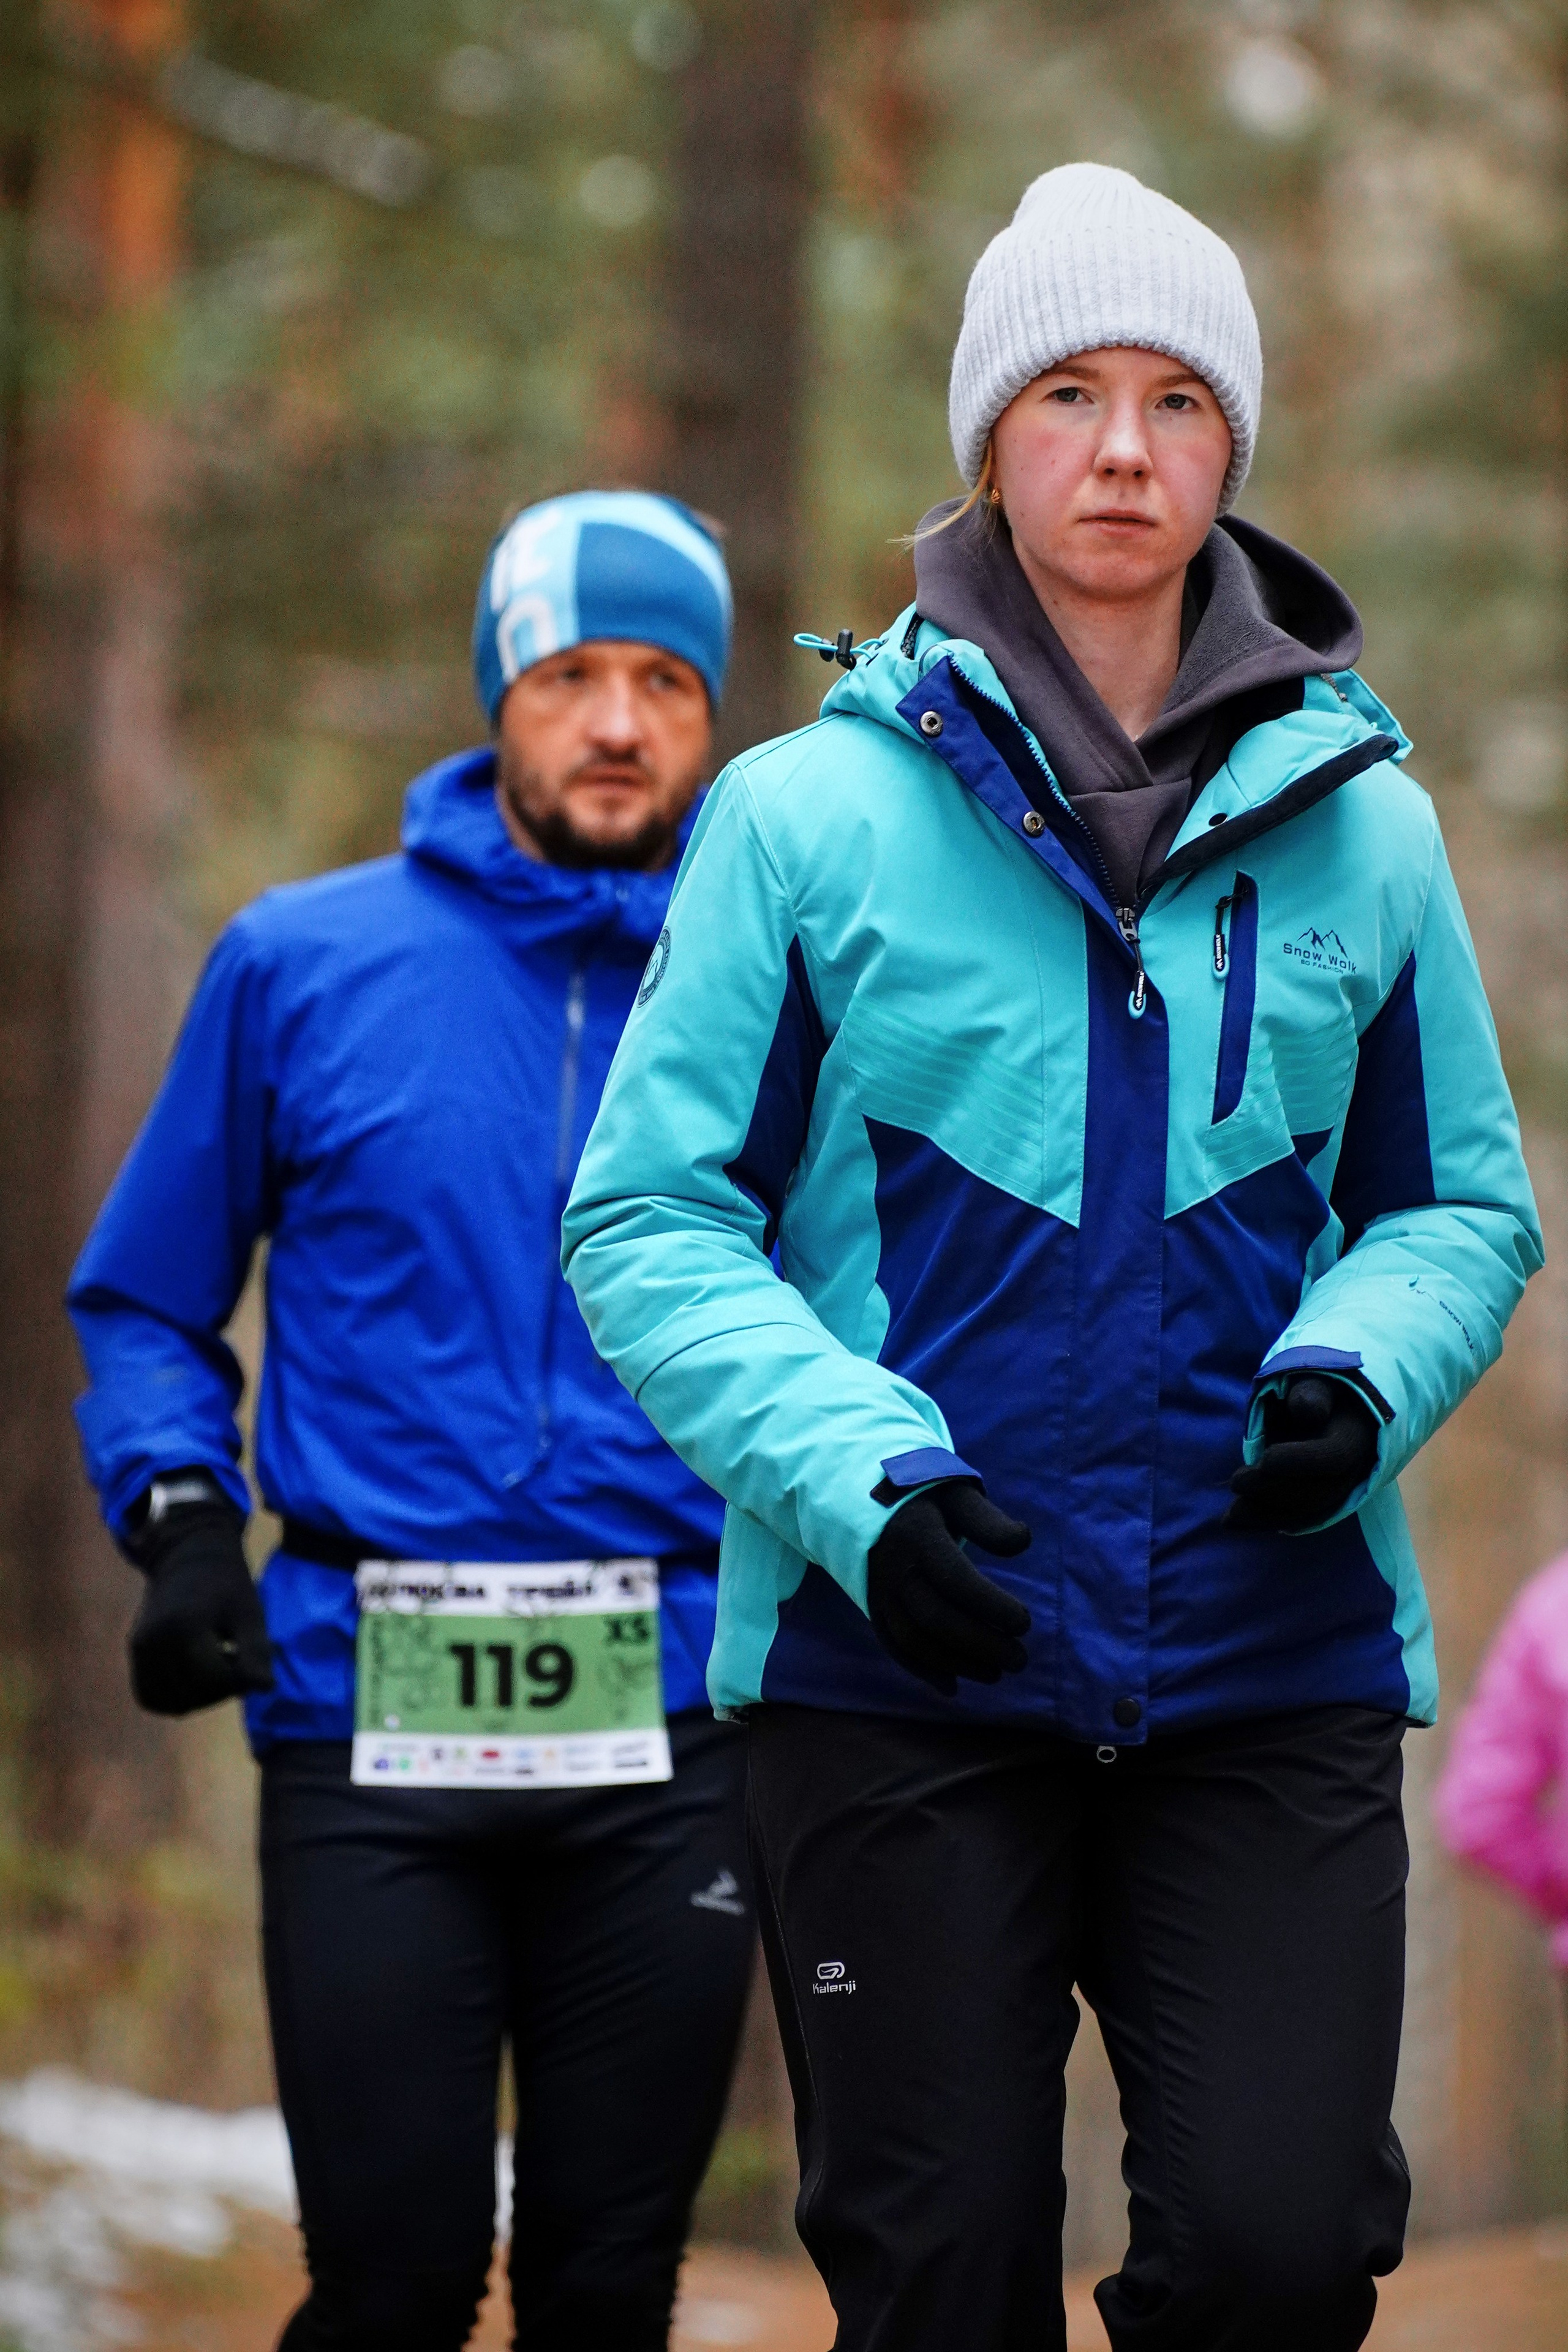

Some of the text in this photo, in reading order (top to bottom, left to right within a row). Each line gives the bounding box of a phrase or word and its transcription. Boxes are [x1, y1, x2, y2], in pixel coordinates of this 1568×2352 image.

[1283, 943, 1322, 961] Snow
[449, 1642, 575, 1708] 119
[812, 1980, 856, 1995] Kalenji
